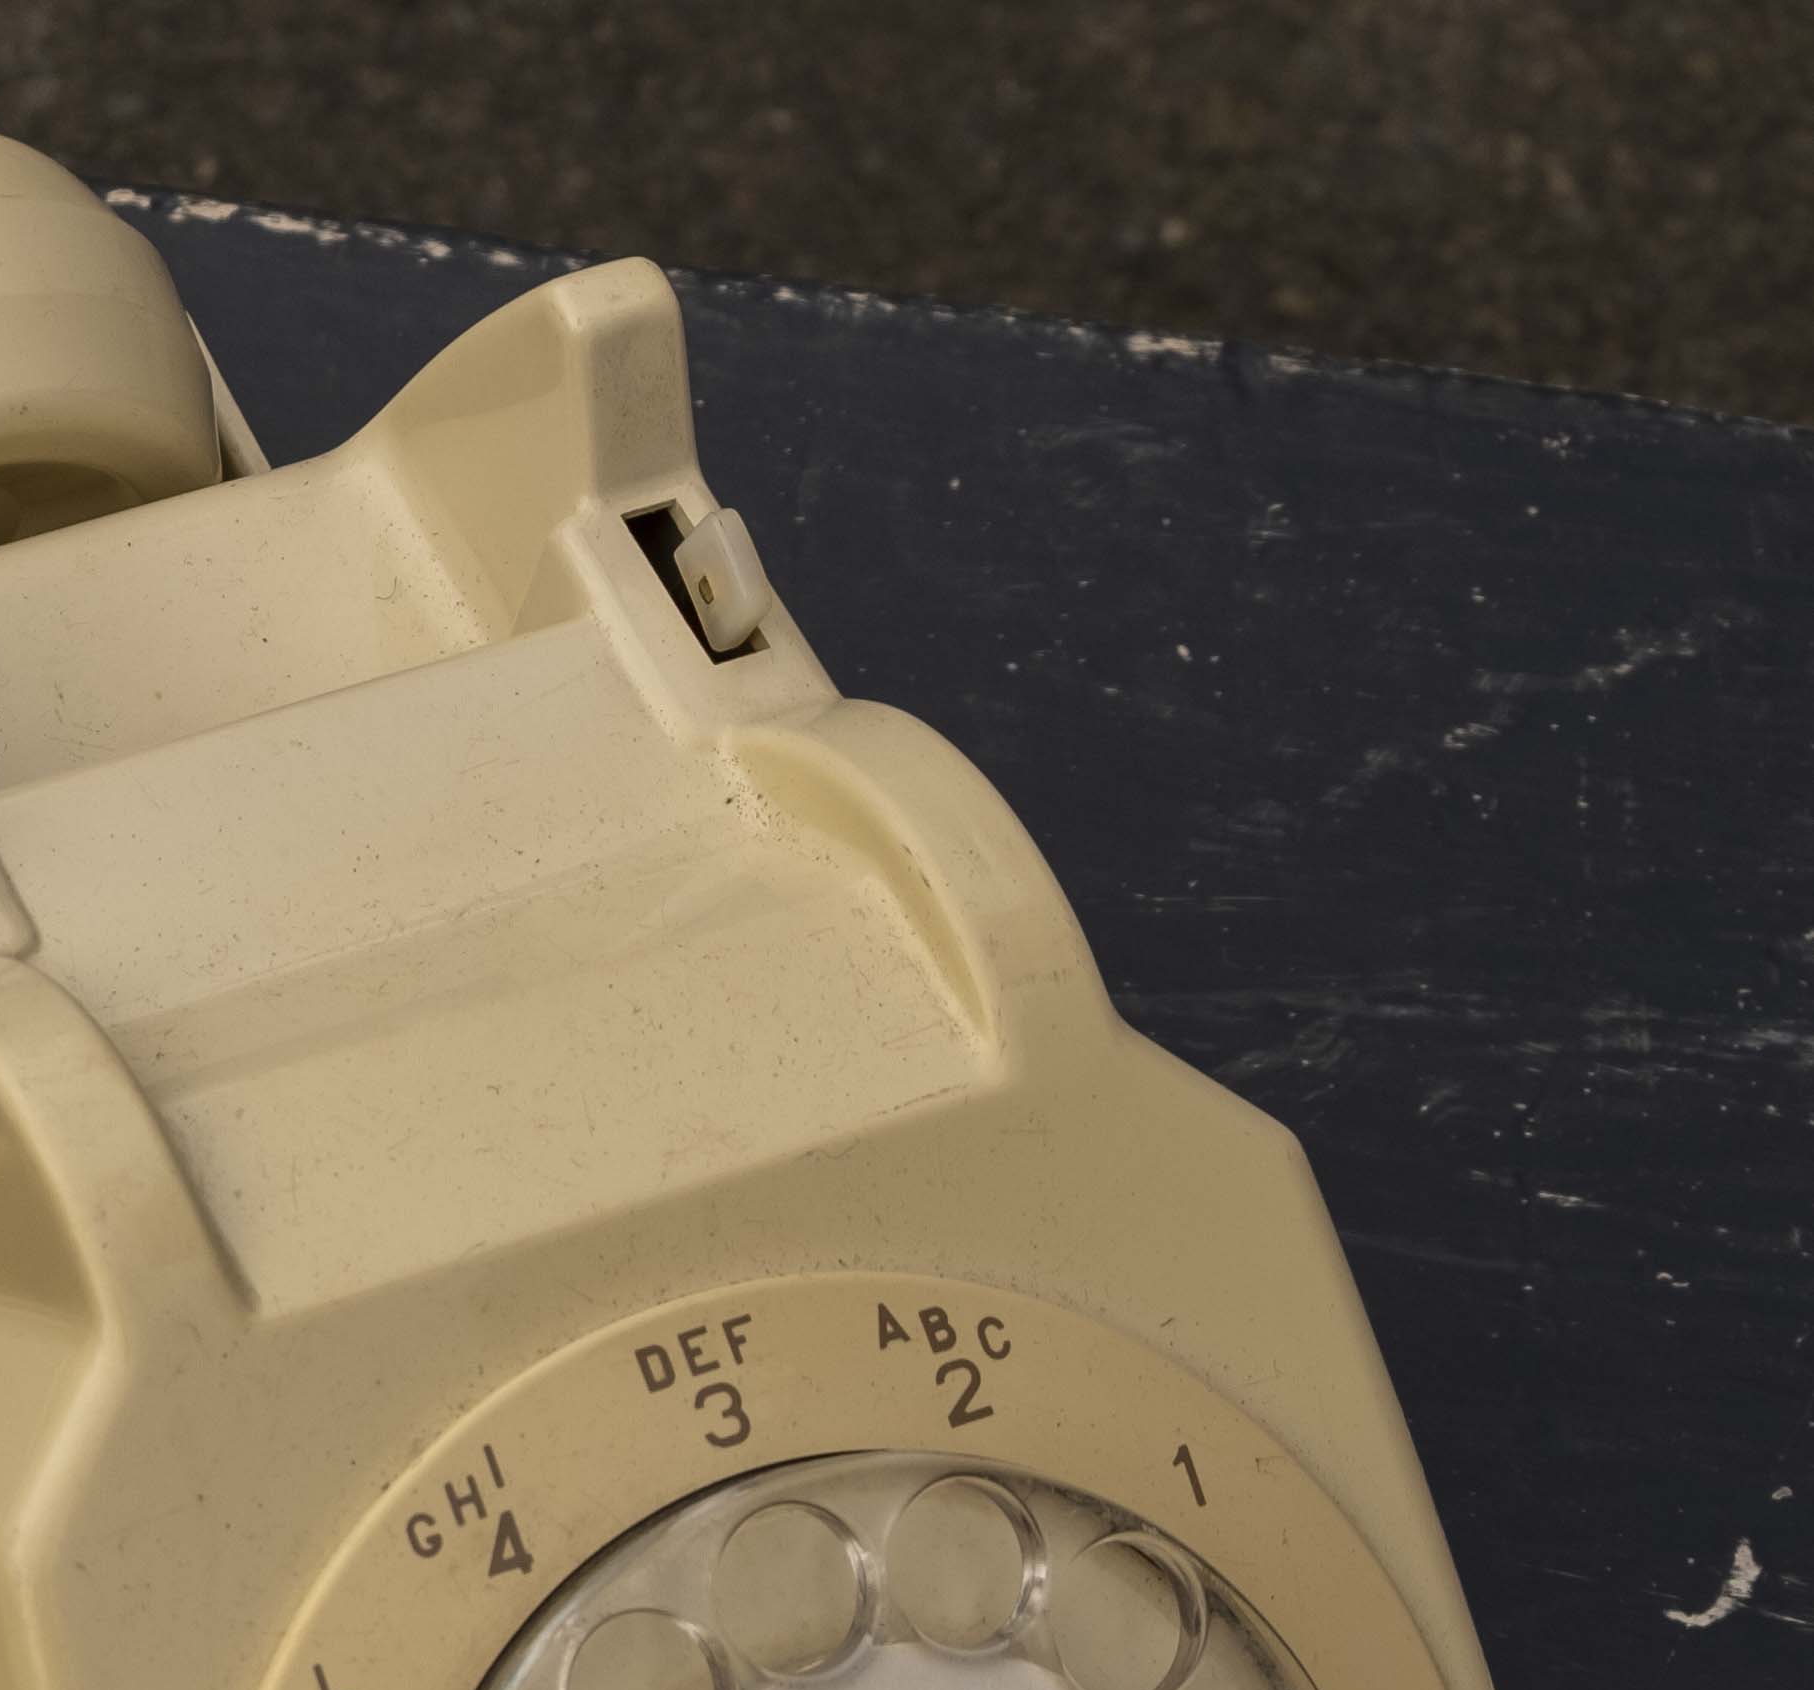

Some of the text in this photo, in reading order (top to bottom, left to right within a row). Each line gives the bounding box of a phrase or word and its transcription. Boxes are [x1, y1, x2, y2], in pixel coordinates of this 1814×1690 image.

[634, 1313, 753, 1394] DEF
[876, 1302, 1012, 1360] ABC
[693, 1381, 752, 1449] 3
[934, 1358, 995, 1429] 2
[406, 1443, 505, 1559] GHI
[1172, 1443, 1207, 1507] 1
[488, 1509, 535, 1578] 4
